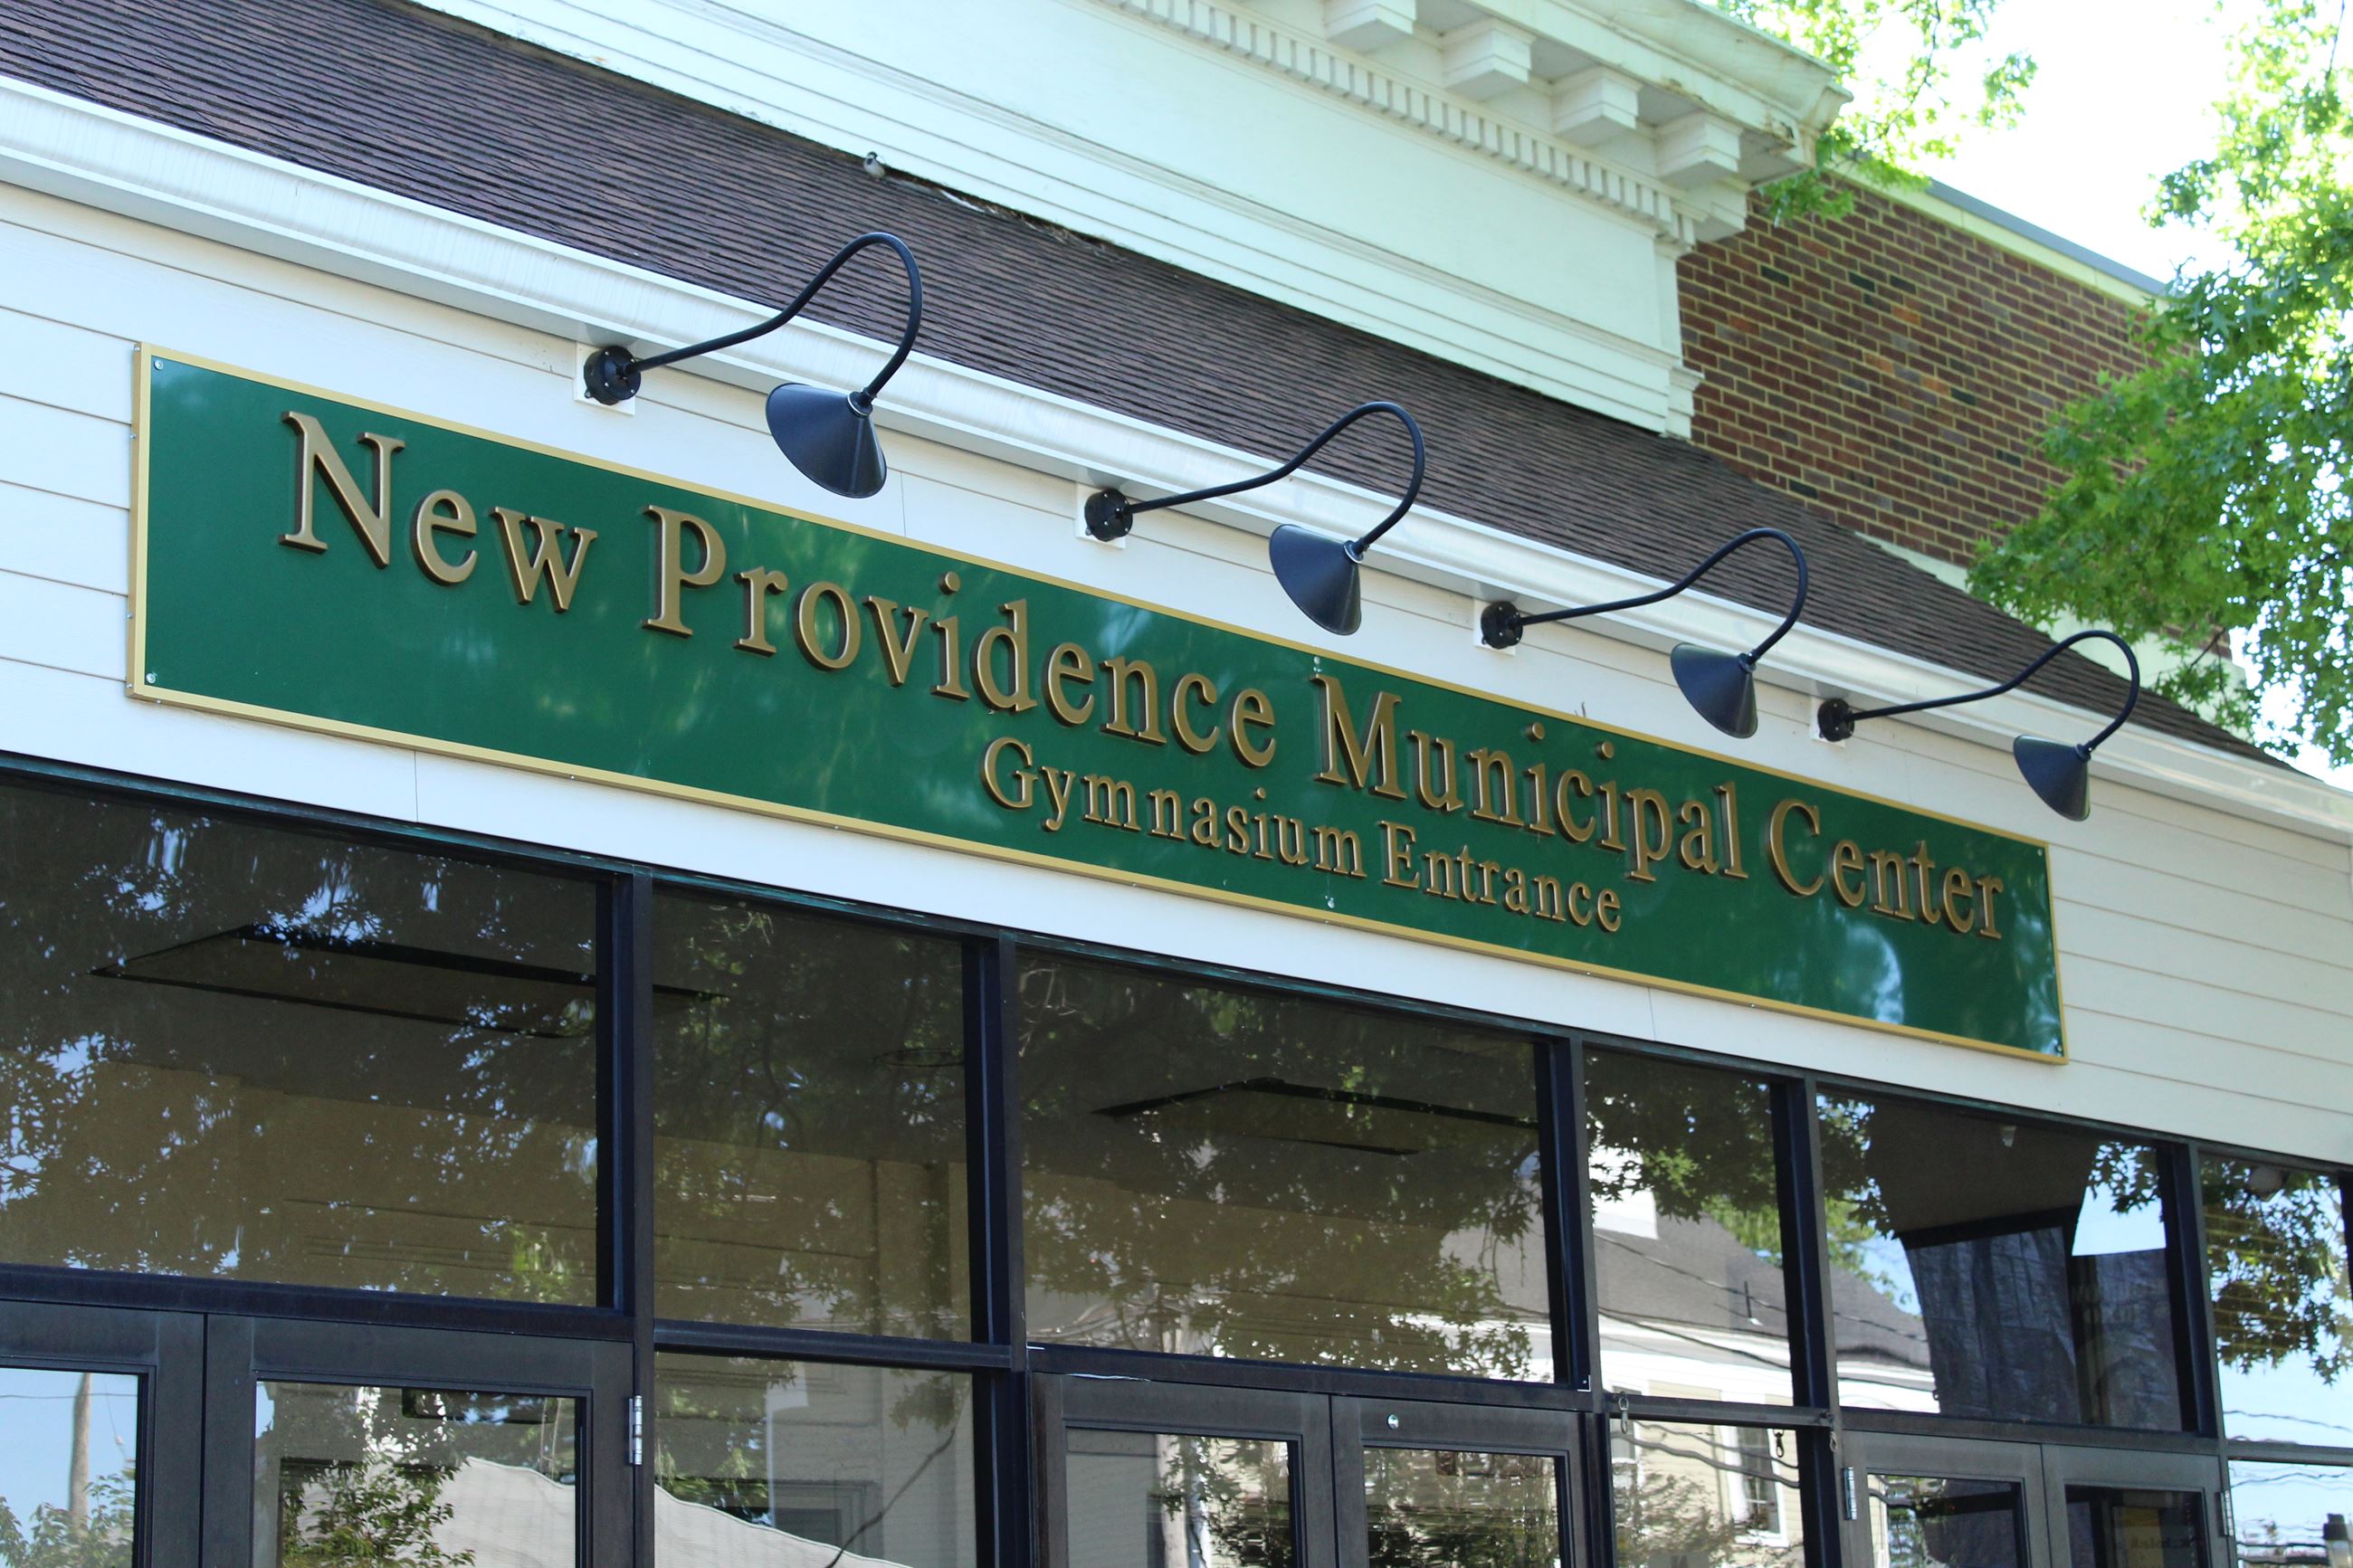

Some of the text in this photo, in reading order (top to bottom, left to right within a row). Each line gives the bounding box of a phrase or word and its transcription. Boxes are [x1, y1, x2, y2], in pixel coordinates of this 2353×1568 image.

[281, 411, 2004, 940] New Providence Municipal Center
[983, 736, 1623, 933] Gymnasium Entrance
